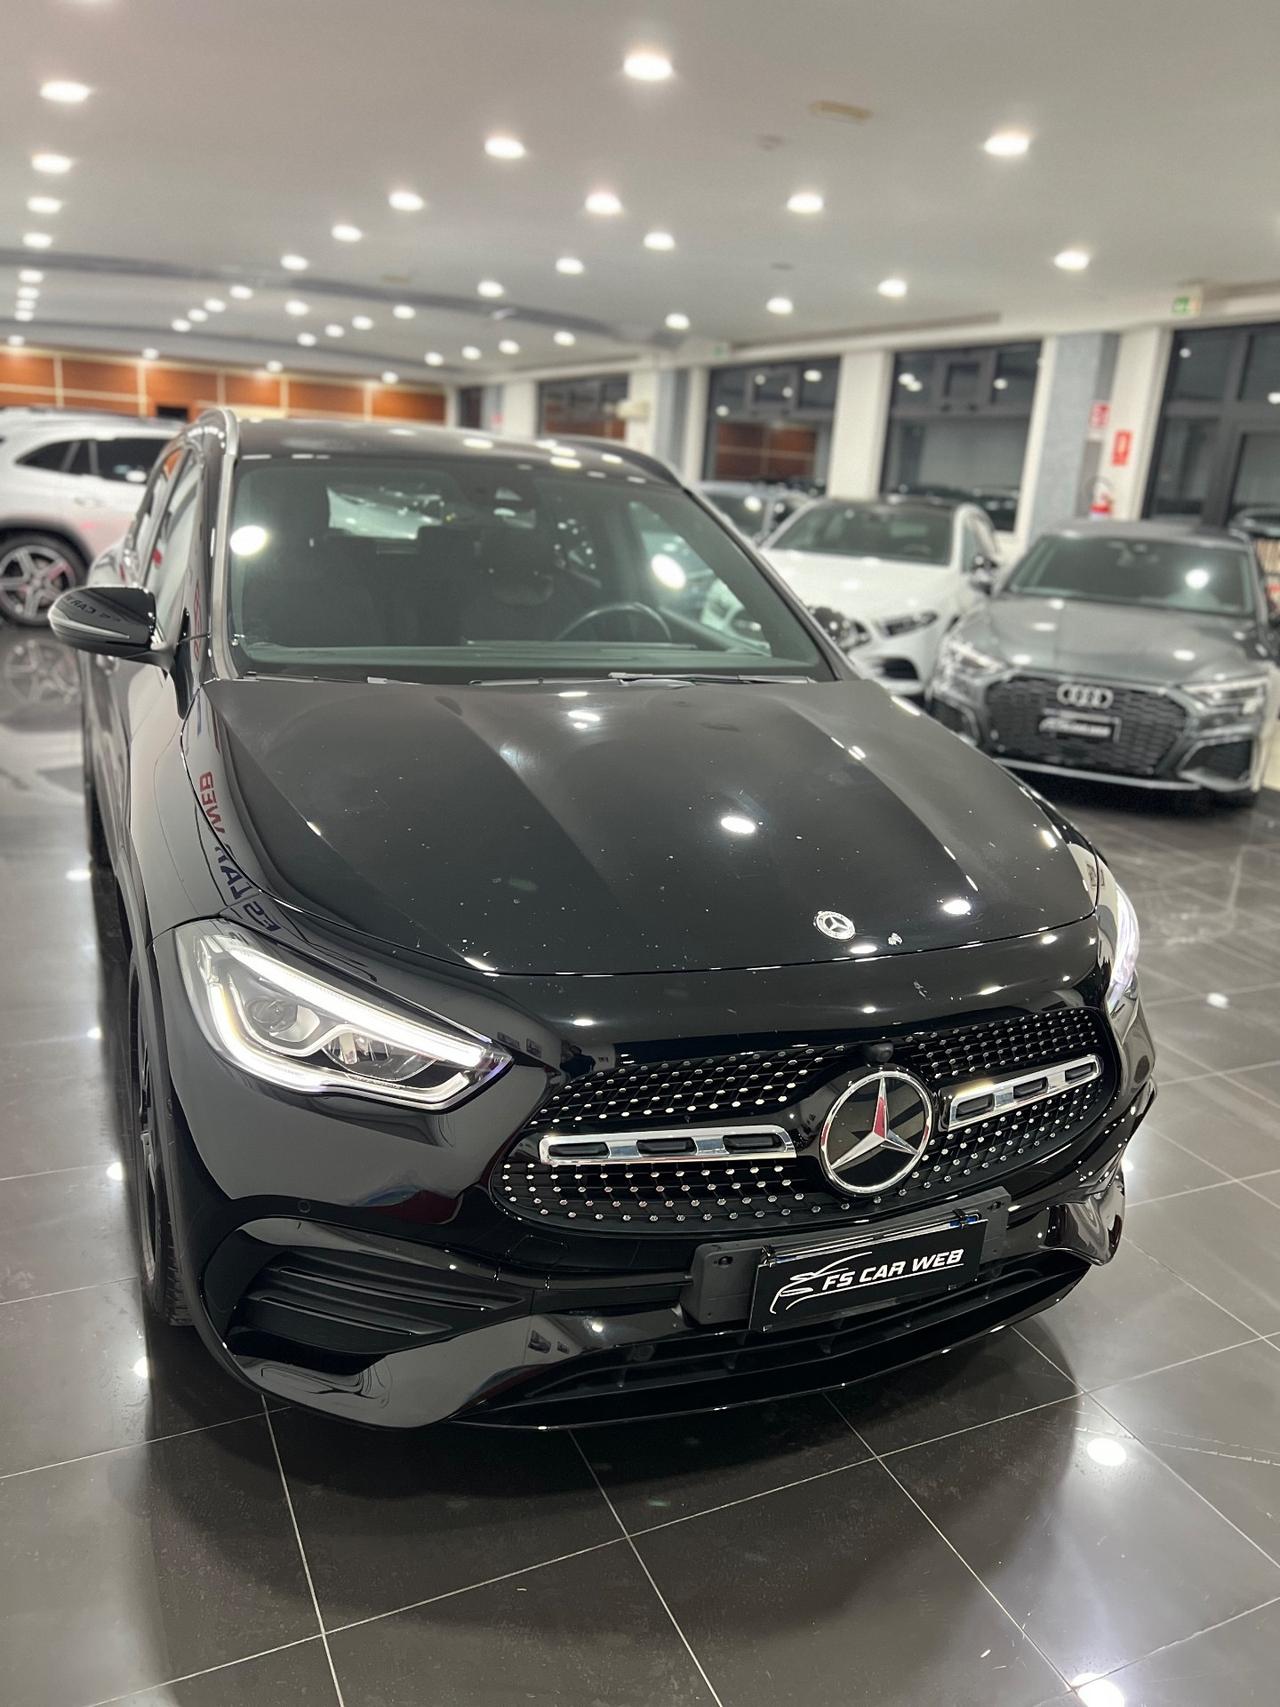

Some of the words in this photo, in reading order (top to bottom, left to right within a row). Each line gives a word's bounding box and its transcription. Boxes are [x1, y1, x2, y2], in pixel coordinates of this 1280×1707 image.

[821, 1270, 856, 1291] FS
[859, 1262, 906, 1284] CAR
[911, 1248, 965, 1271] WEB
